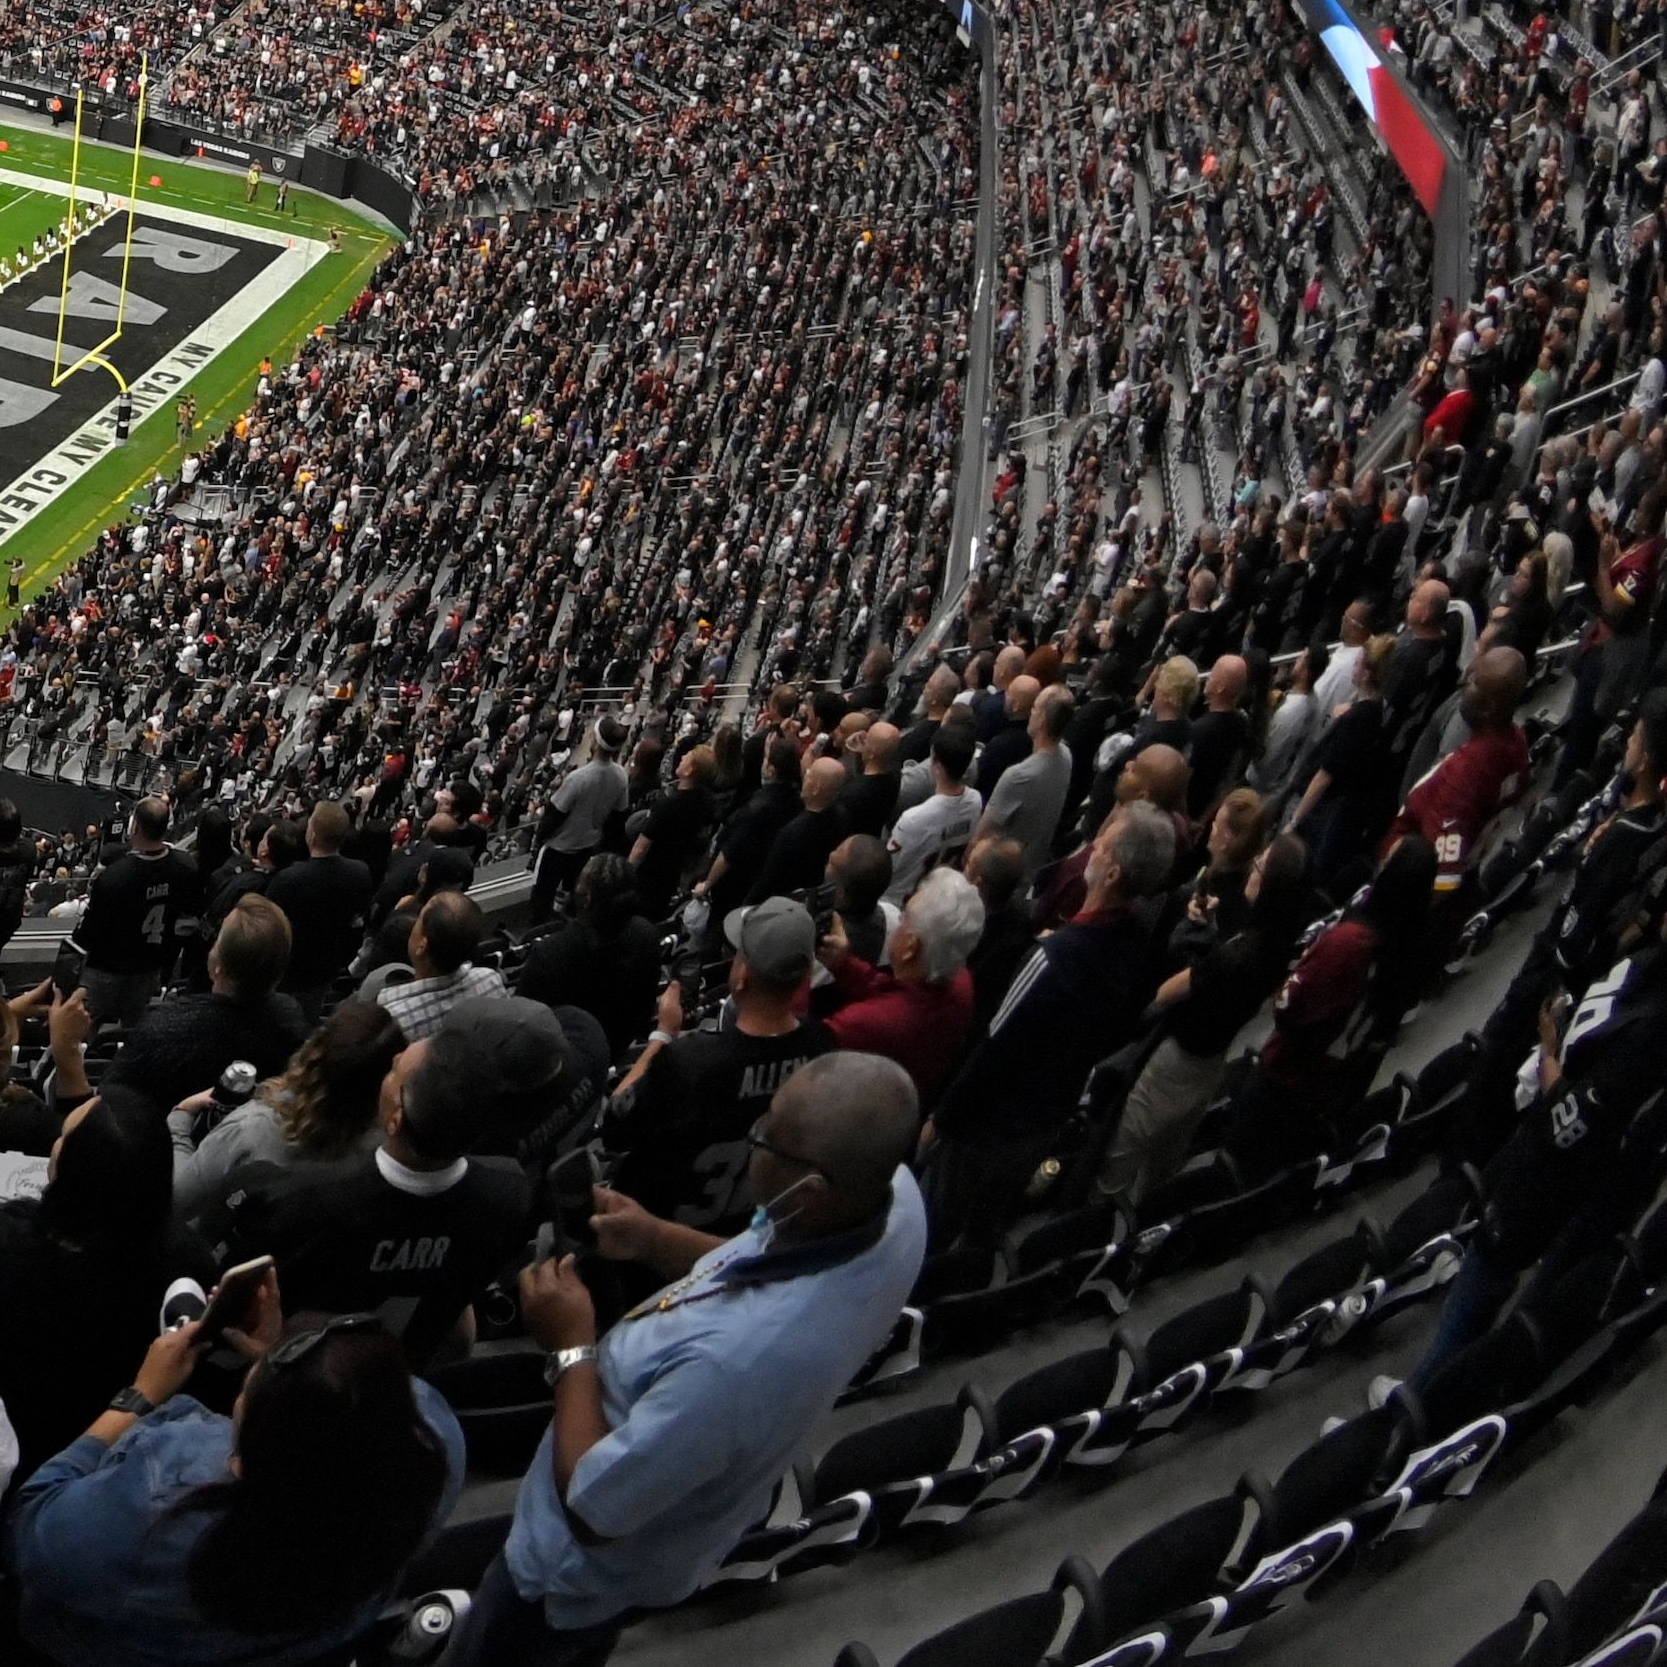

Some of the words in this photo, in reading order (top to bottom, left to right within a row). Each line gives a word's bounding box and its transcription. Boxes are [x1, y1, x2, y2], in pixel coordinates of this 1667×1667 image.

[171, 342, 215, 369] MY
[58, 434, 110, 466] MY
[145, 883, 169, 901] CARR
[142, 904, 166, 944] 4
[369, 1236, 452, 1273] CARR
